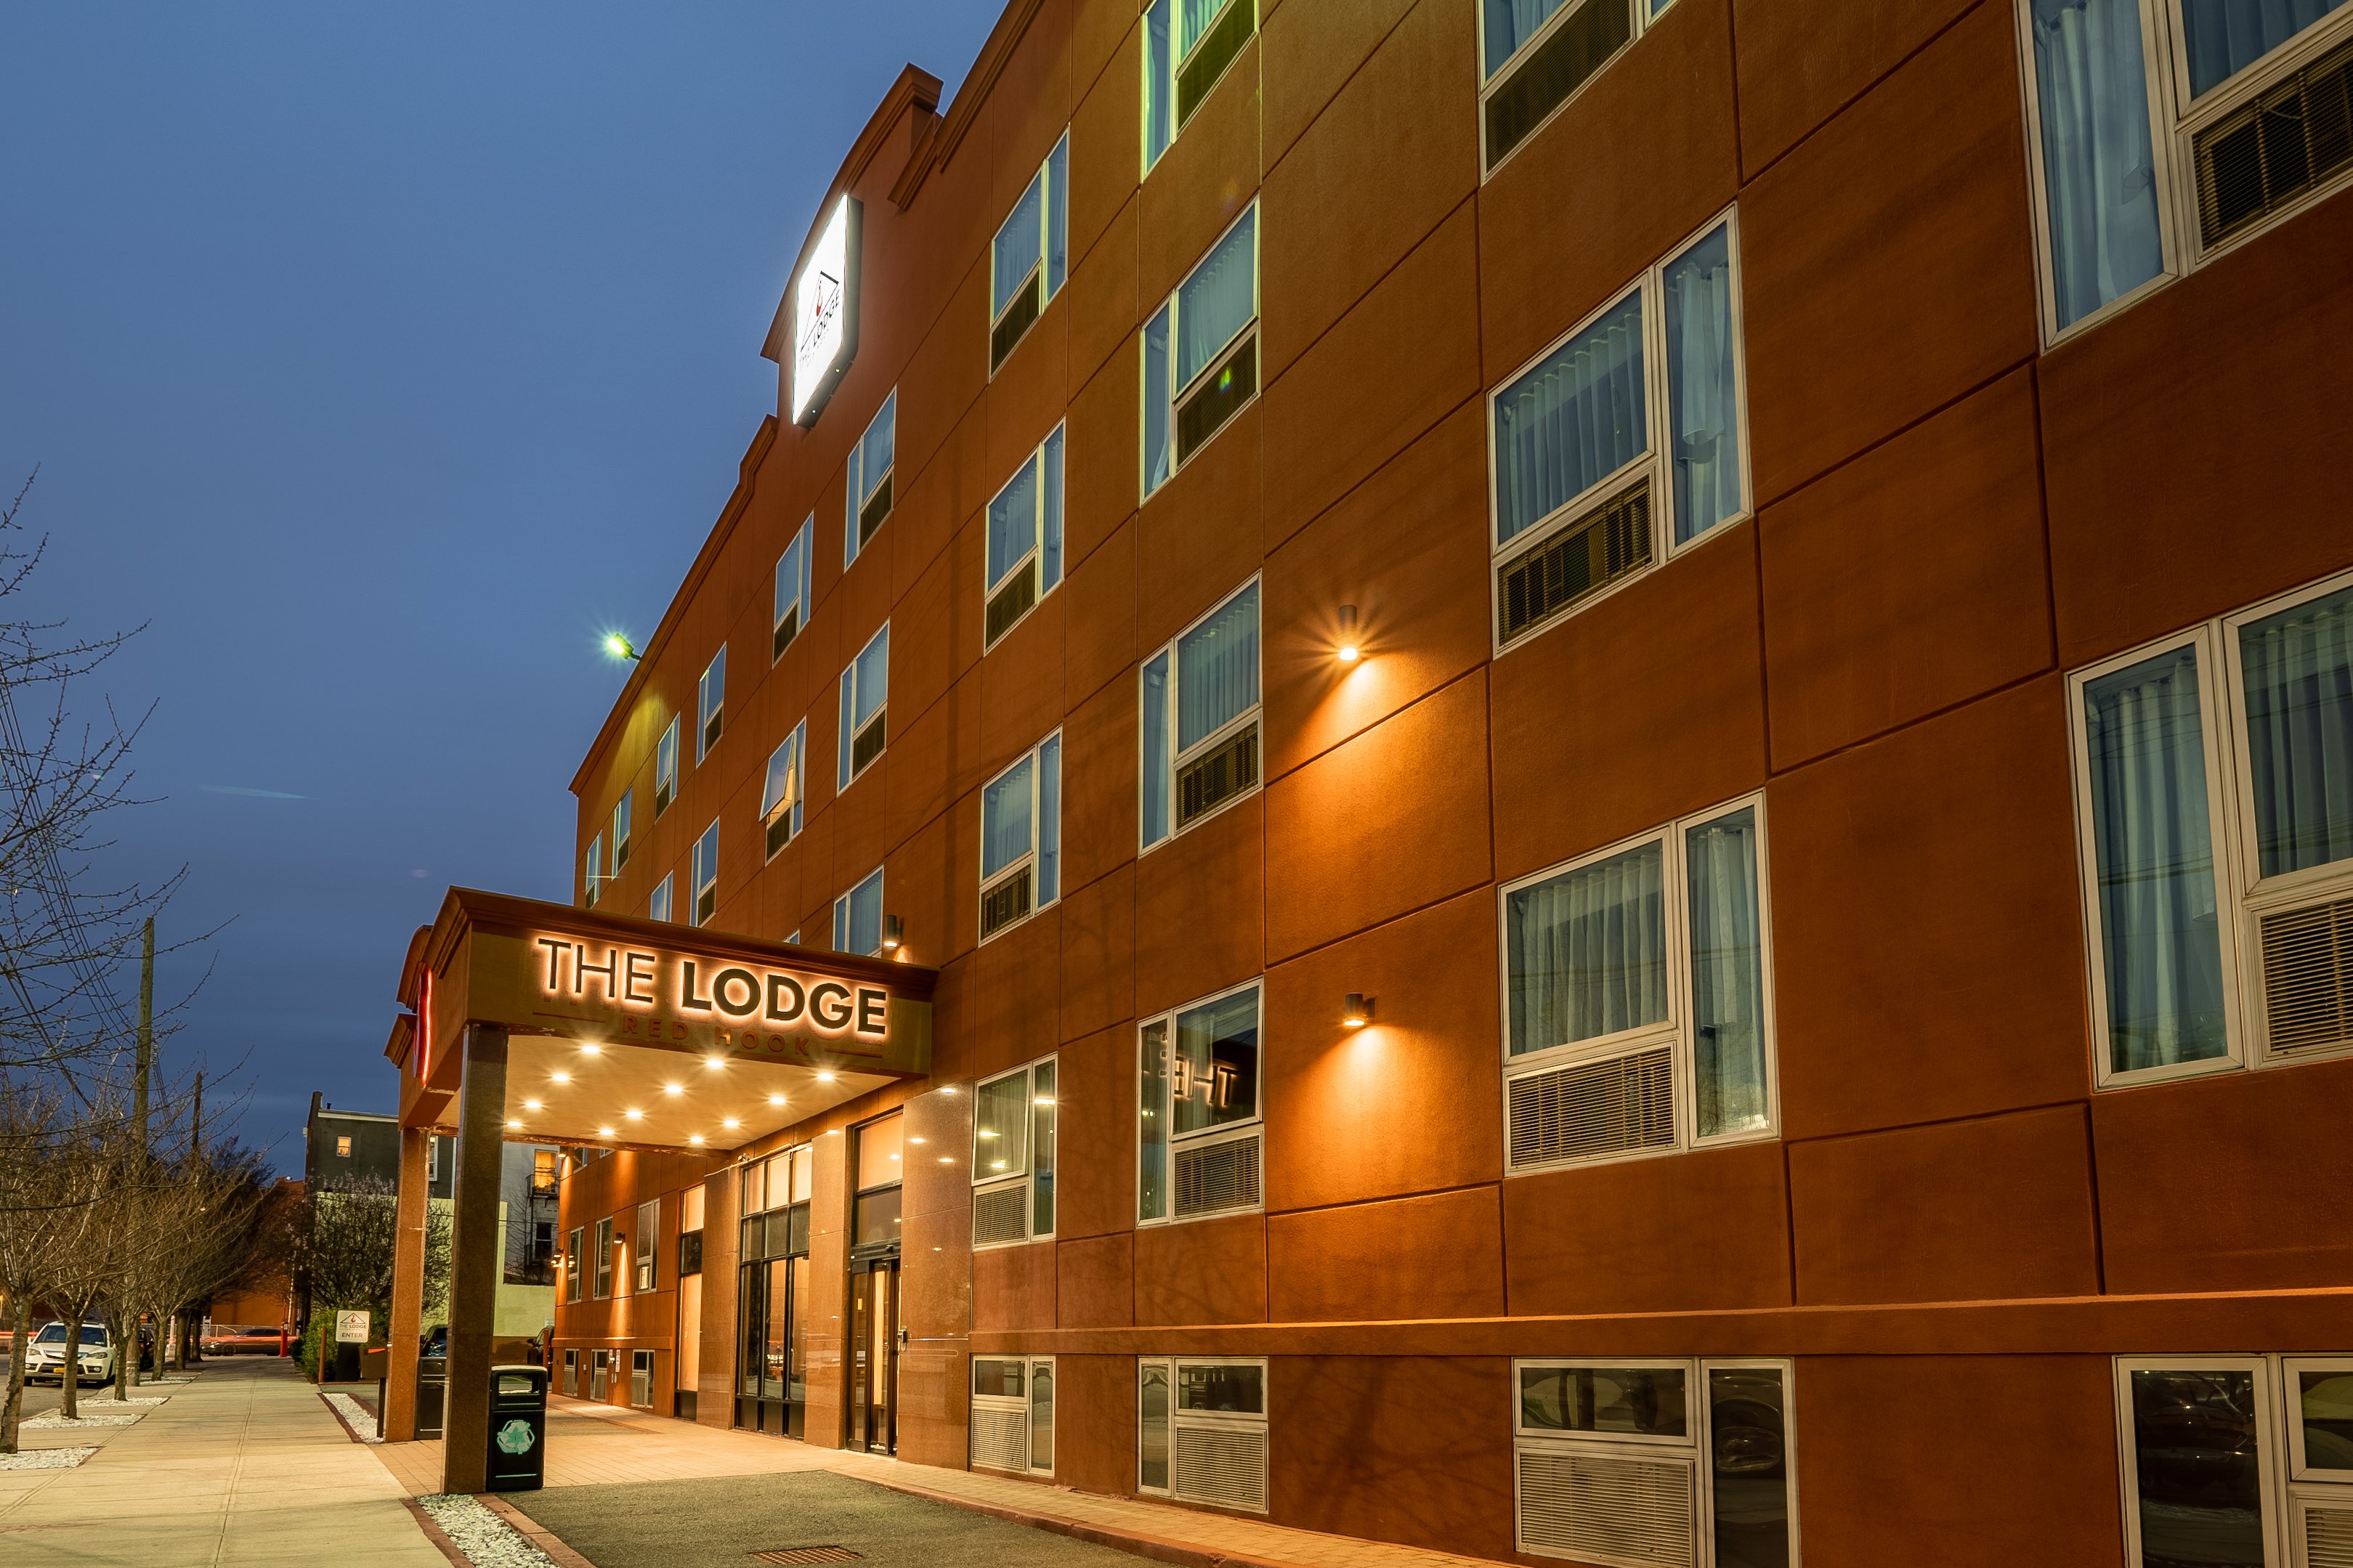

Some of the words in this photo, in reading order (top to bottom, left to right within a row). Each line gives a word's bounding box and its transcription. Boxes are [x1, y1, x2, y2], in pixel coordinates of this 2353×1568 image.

[538, 938, 655, 1003] THE
[681, 961, 886, 1034] LODGE
[623, 1015, 689, 1040] RED
[714, 1026, 810, 1056] HOOK
